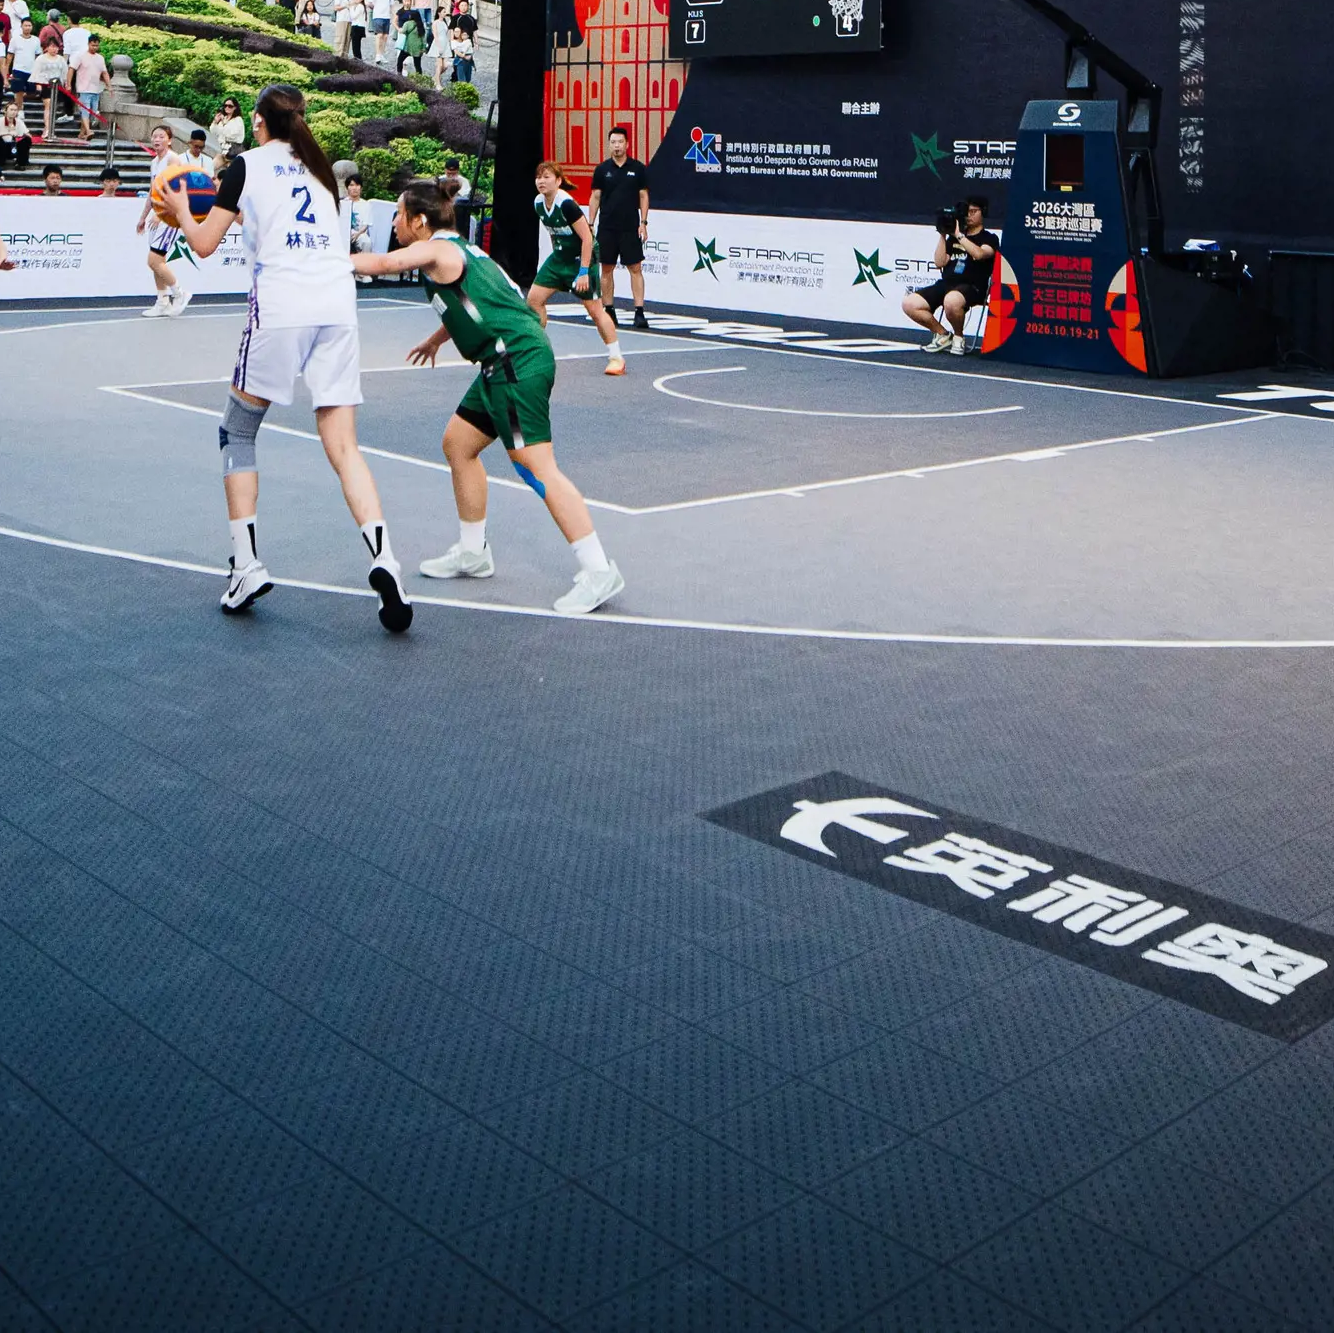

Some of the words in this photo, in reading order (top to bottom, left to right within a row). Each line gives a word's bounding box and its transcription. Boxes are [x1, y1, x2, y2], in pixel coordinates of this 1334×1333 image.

[691, 23, 700, 39] 7
[842, 15, 853, 32] 4
[842, 102, 880, 115] 聯合主辦
[753, 155, 762, 163] do
[764, 155, 795, 164] Desporto
[809, 157, 839, 165] Governo
[841, 158, 851, 166] da
[853, 158, 877, 166] RAEM
[750, 166, 775, 174] Bureau
[786, 167, 809, 175] Macao
[830, 169, 876, 177] Government
[292, 186, 315, 223] 2
[1033, 202, 1095, 217] 2026大灣區
[728, 245, 825, 266] STARMAC
[729, 260, 773, 270] Entertainment
[775, 264, 810, 273] Production
[1026, 323, 1099, 340] 2026.10.19-21
[884, 832, 1328, 1004] 英利奧
